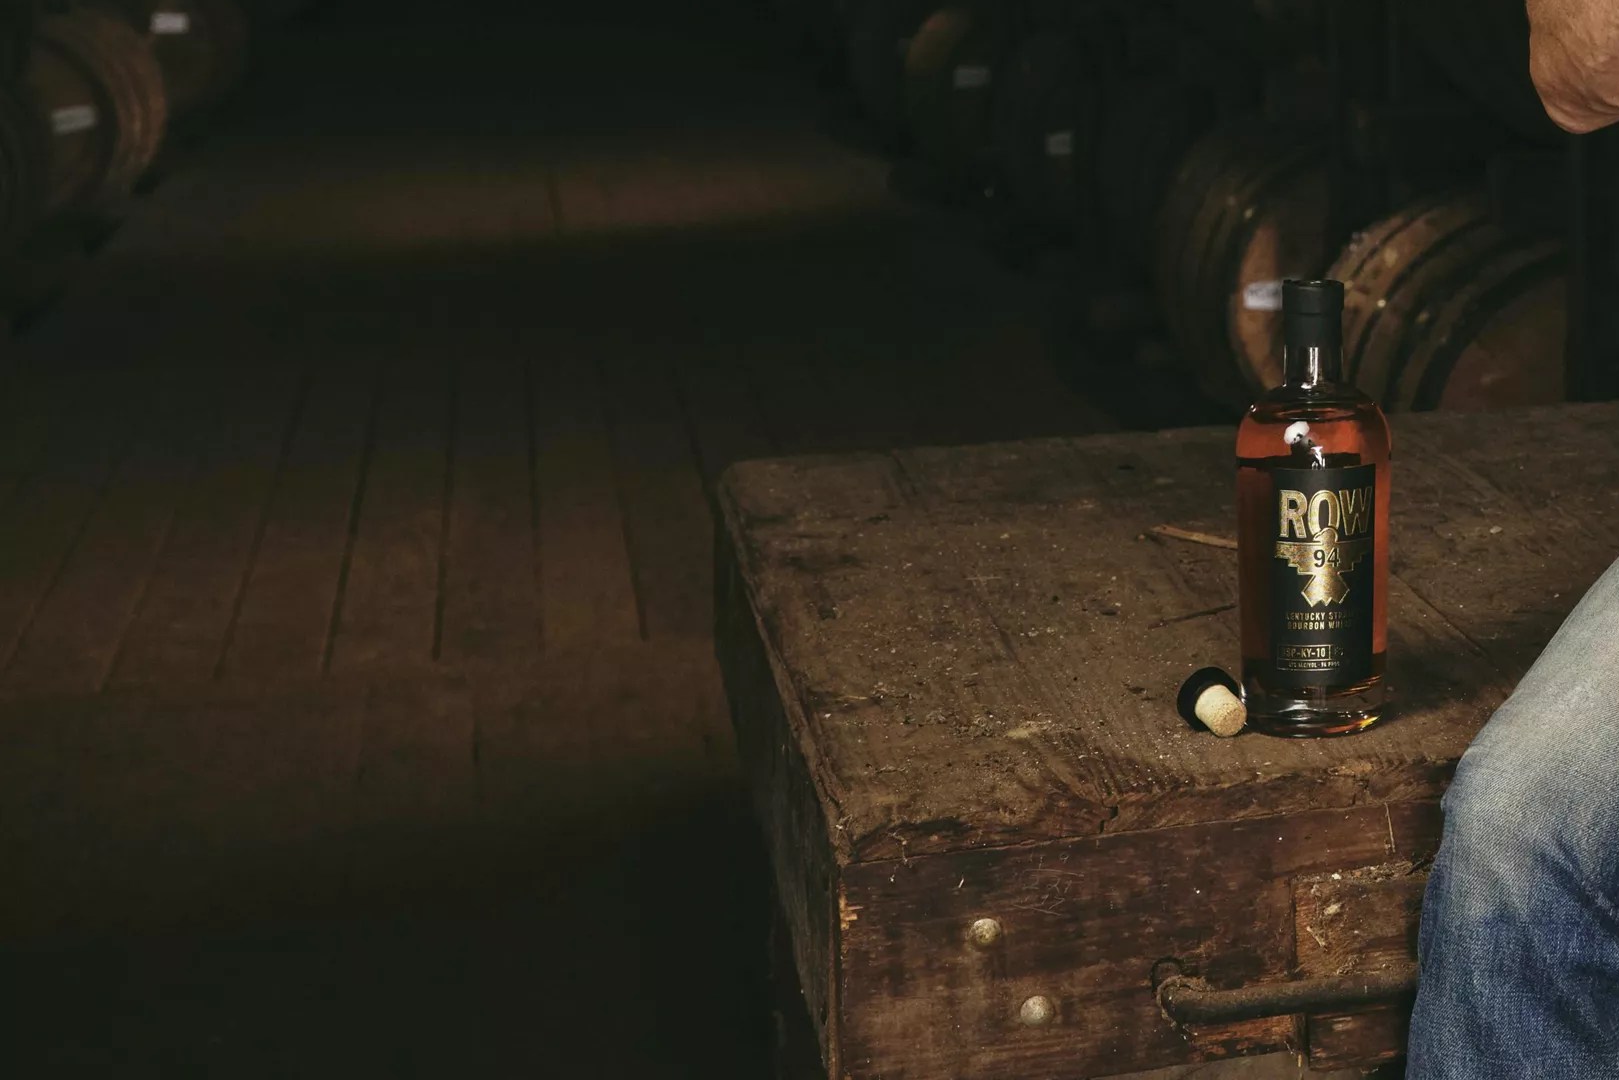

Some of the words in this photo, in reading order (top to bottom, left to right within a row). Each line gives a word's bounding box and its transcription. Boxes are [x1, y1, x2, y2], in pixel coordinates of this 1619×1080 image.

[1279, 486, 1373, 539] ROW
[1313, 547, 1340, 568] 94
[1287, 621, 1326, 630] BOURBON
[1281, 647, 1326, 658] SP-KY-10
